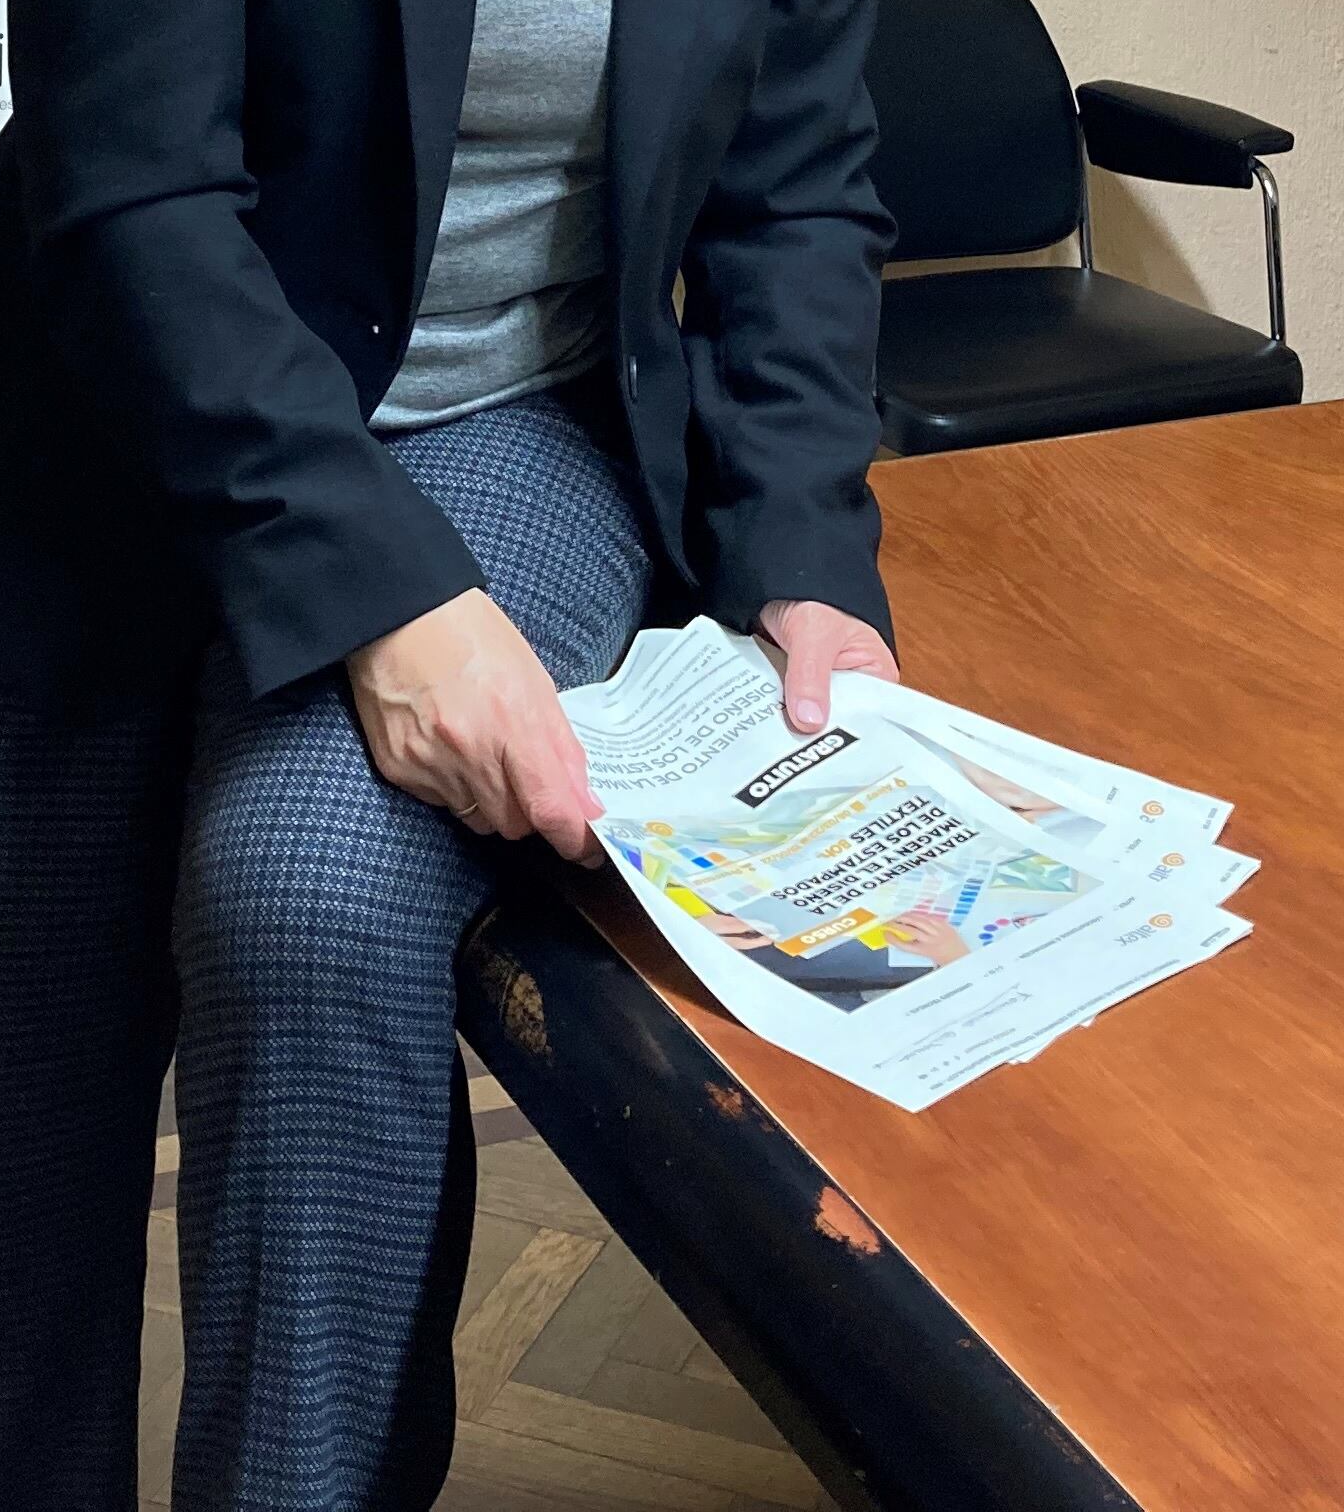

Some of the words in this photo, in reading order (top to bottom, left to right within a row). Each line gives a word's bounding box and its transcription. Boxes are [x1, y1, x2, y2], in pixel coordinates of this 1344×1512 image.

[710, 681, 777, 727] DISEÑO
[684, 724, 714, 747] DE
[650, 743, 689, 770] LOS
[746, 732, 843, 801] GRATUITO
[629, 776, 655, 790] LA
[652, 771, 682, 787] DE
[848, 795, 931, 845] TEXTILES
[914, 806, 946, 828] DE
[884, 822, 918, 846] LOS
[895, 817, 962, 858] IMAGEN
[853, 862, 882, 878] EL
[860, 827, 978, 892] TRATAMIENTO
[886, 853, 899, 865] Y
[769, 842, 886, 903] ESTAMPADOS
[791, 875, 858, 910] DISEÑO
[834, 887, 863, 906] DE
[809, 902, 837, 917] LA
[798, 915, 858, 946] CURSO
